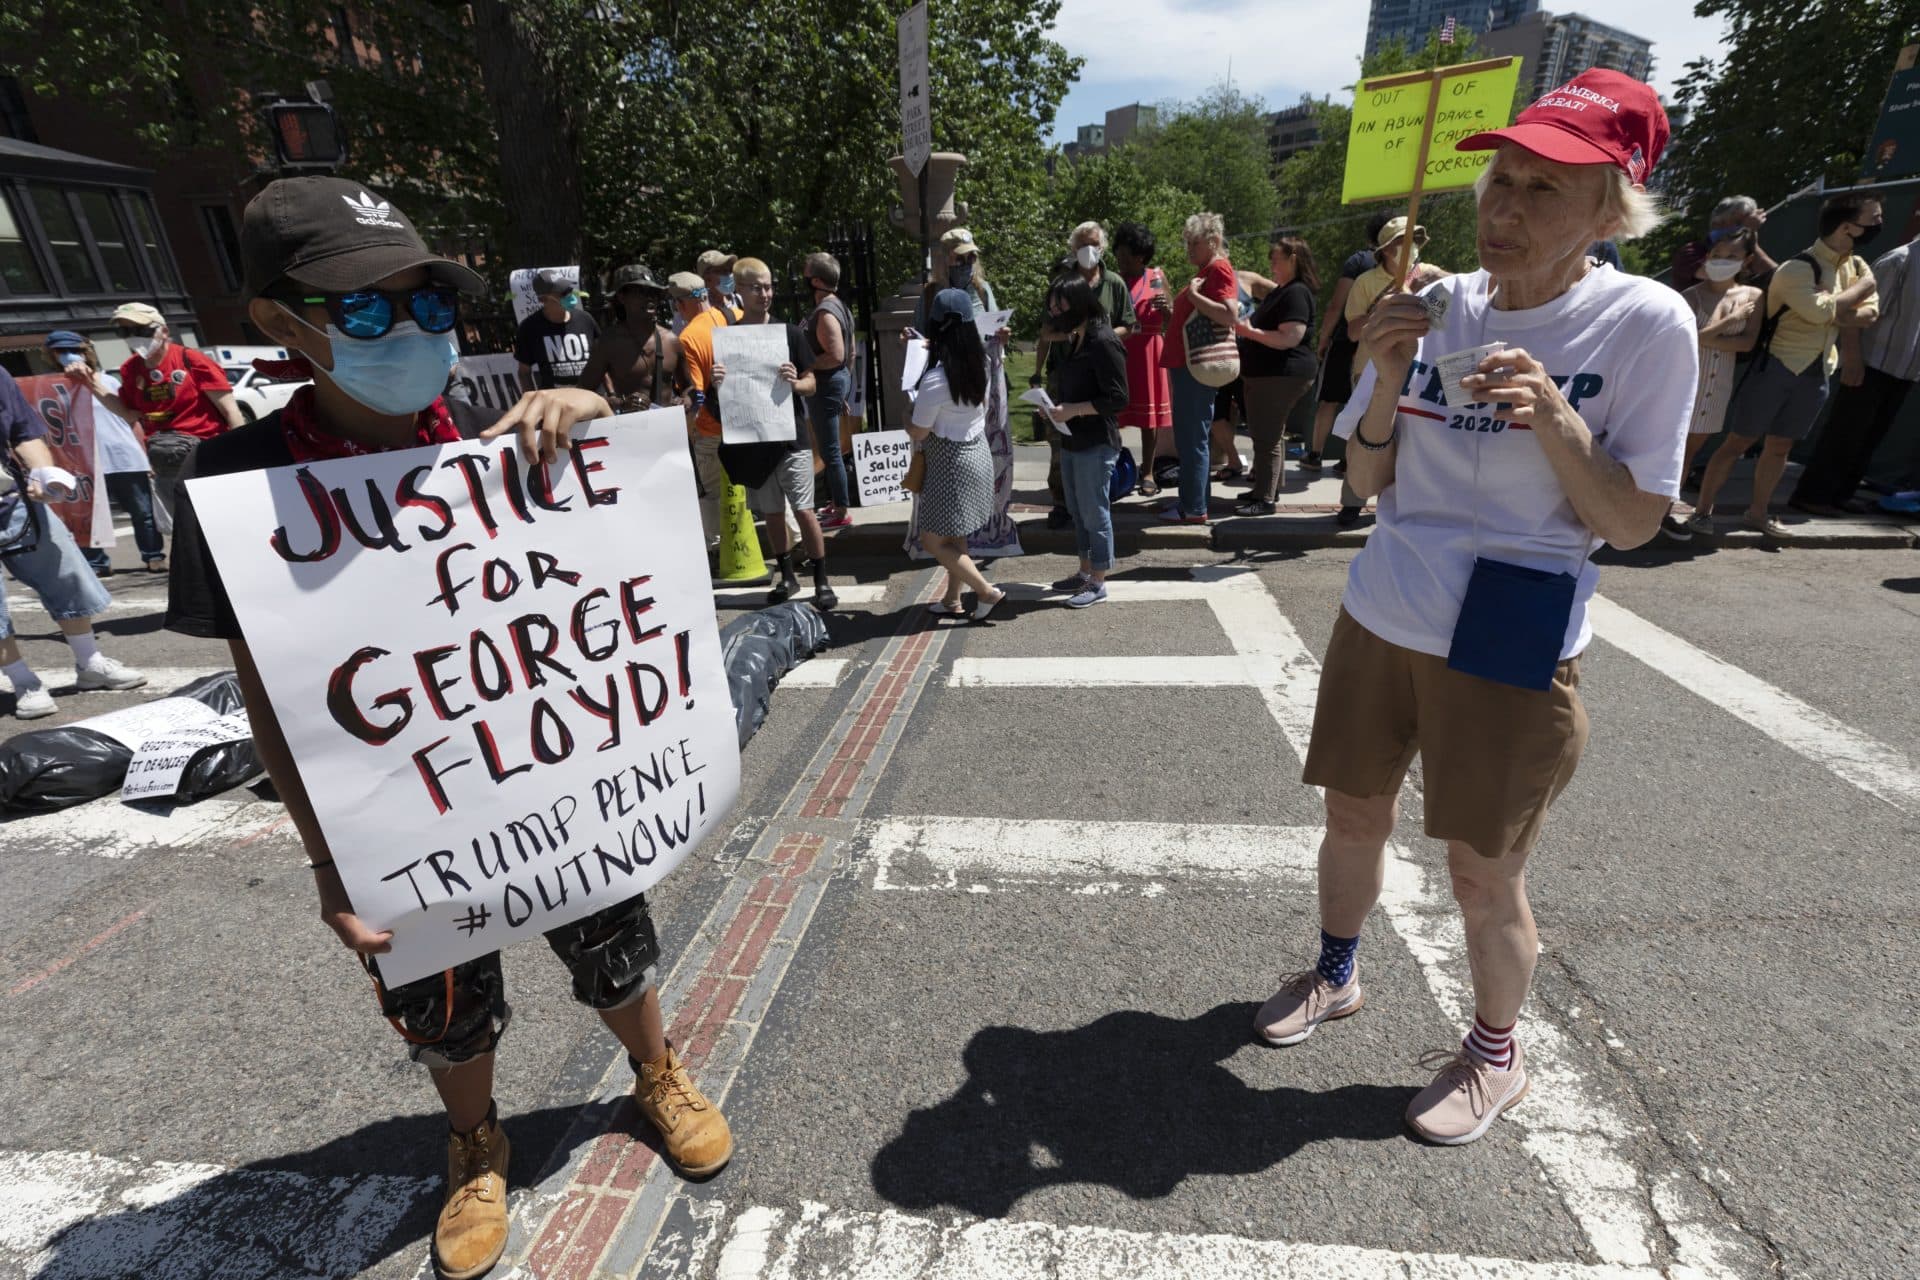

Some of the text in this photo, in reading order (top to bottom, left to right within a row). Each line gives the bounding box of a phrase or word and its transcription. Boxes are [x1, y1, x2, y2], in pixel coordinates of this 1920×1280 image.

[1371, 80, 1479, 108] OUT OF
[1560, 84, 1620, 113] AMERICA
[907, 104, 922, 120] PARK
[904, 116, 926, 134] STREET
[1356, 120, 1377, 134] AN
[1384, 124, 1498, 150] OF CAUT
[356, 216, 404, 229] adidas
[543, 333, 590, 363] NO!
[1449, 414, 1506, 433] 2020
[857, 439, 911, 461] ¡Asegur
[869, 454, 907, 472] salud
[862, 470, 904, 485] carcel
[270, 437, 622, 563] JUSTICE
[864, 484, 902, 497] campo
[326, 575, 667, 746] GEORGE
[411, 630, 697, 816] FLOYD!
[129, 760, 143, 774] IT
[381, 737, 707, 912] TRUMP PENCE
[453, 782, 708, 938] #OUTNOW!
